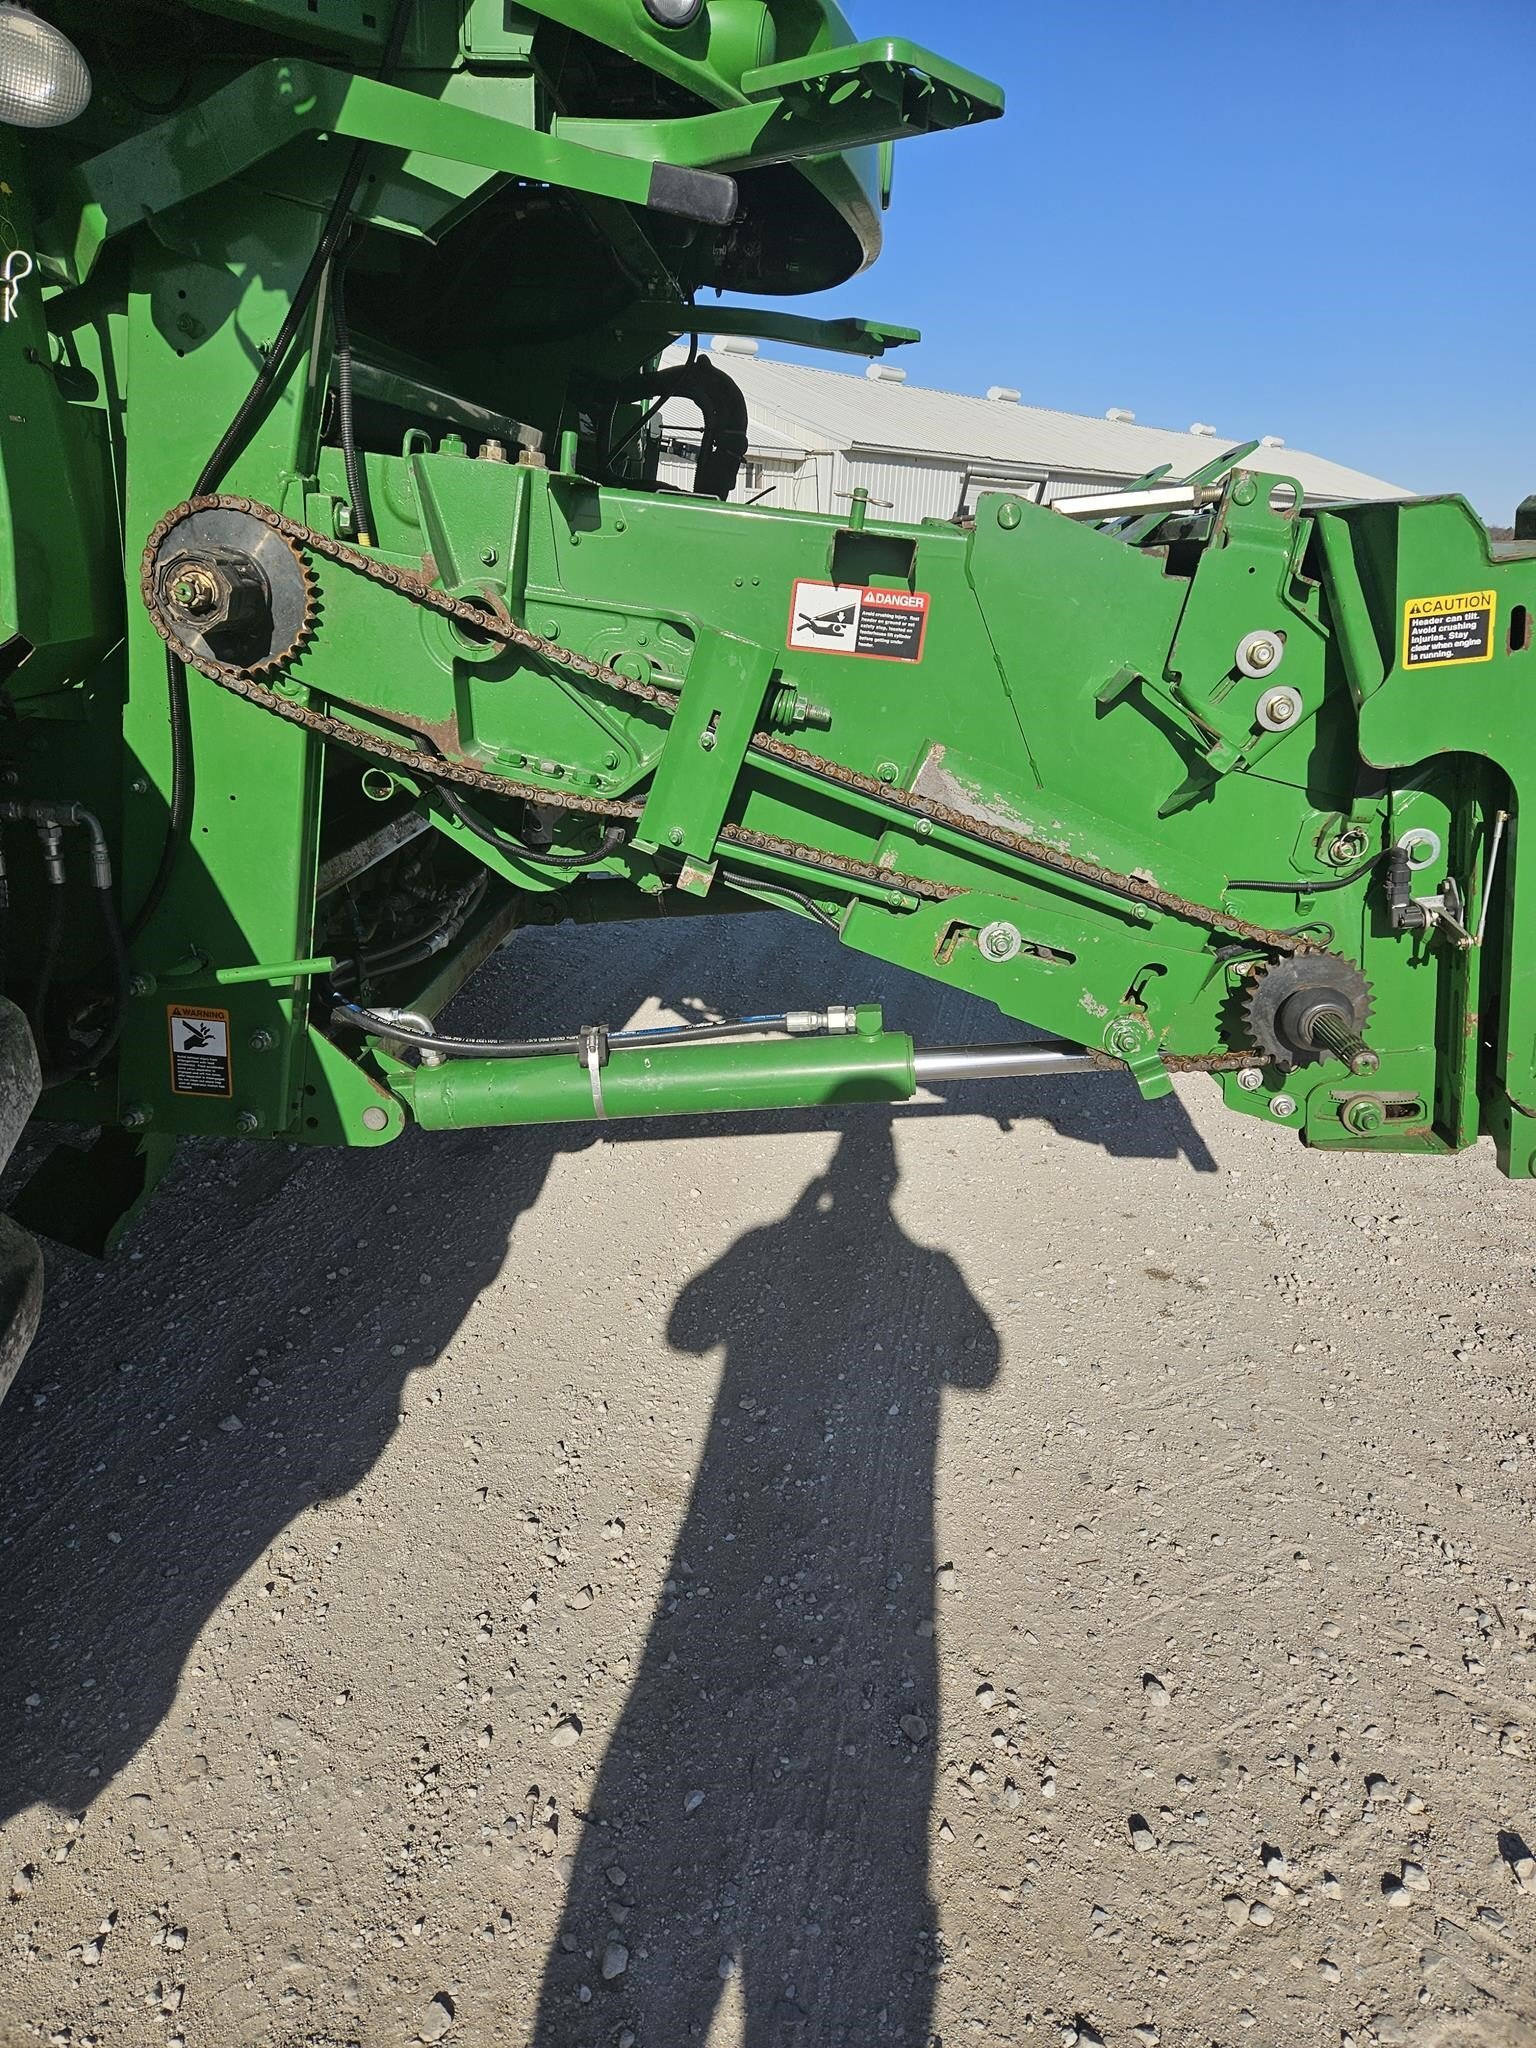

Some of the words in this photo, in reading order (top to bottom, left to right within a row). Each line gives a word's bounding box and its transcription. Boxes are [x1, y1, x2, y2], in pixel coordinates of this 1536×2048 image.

[876, 593, 924, 608] DANGER
[1423, 595, 1490, 613] CAUTION
[1412, 617, 1443, 626] Header
[1412, 626, 1436, 635] Avoid
[1438, 622, 1476, 631] crushing
[1411, 634, 1446, 644] injuries.
[1432, 641, 1453, 649] when
[1454, 638, 1481, 647] engine
[1420, 650, 1454, 659] running.
[183, 1008, 224, 1019] WARNING
